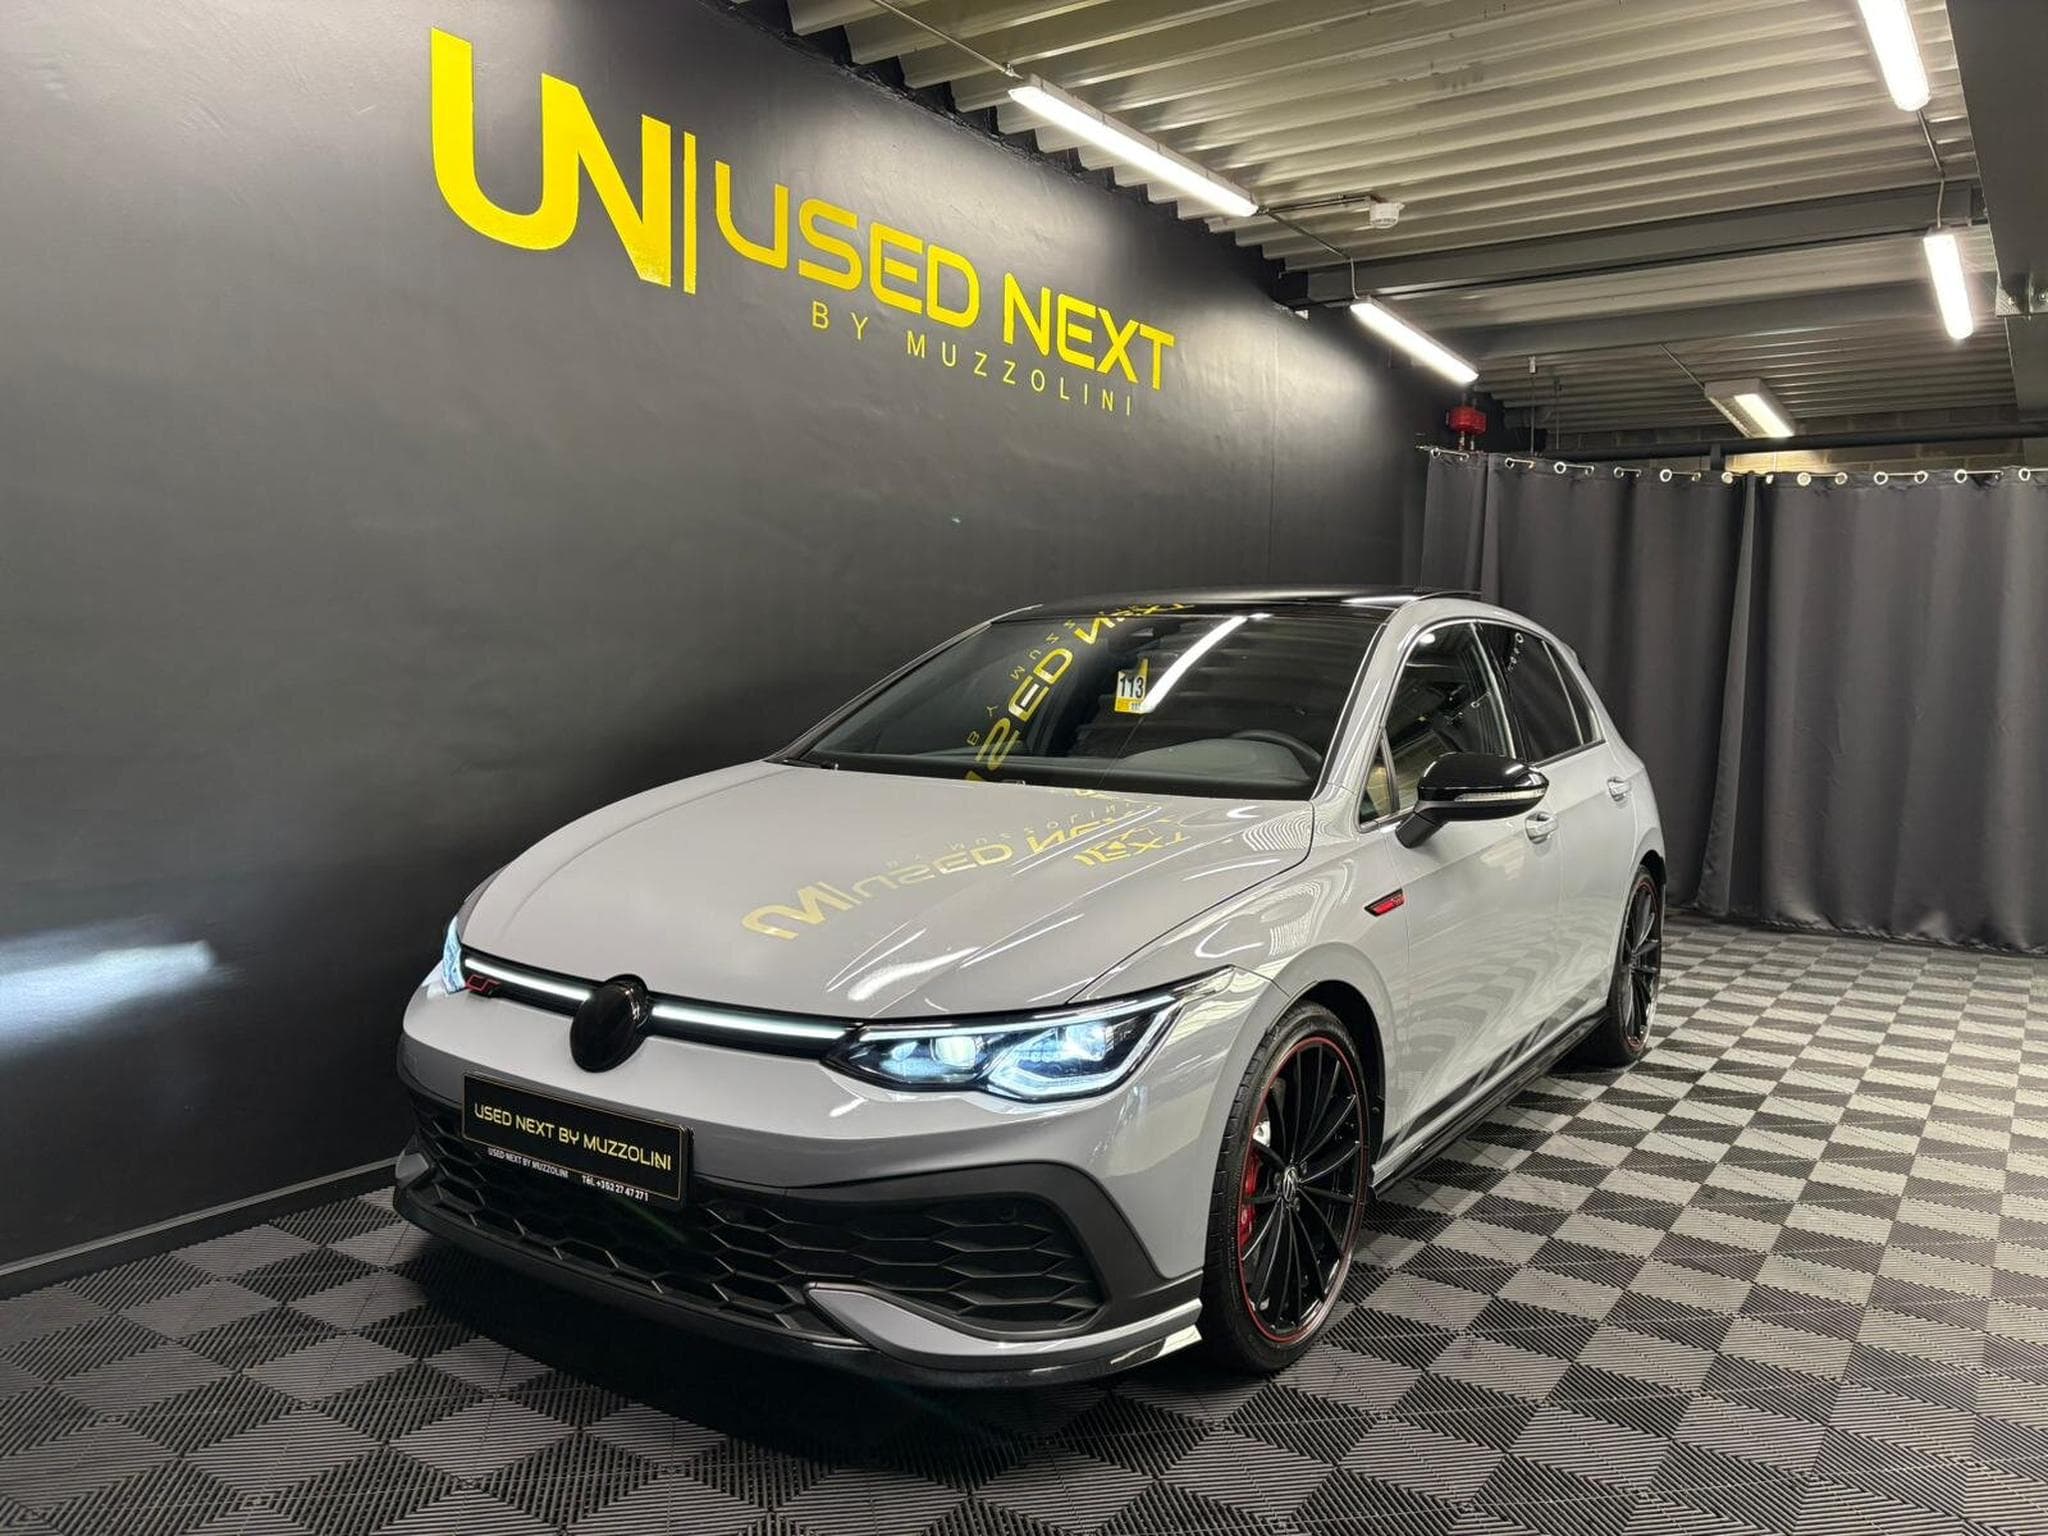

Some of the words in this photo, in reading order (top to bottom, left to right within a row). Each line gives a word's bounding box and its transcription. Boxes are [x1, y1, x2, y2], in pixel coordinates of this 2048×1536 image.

[715, 160, 981, 328] USED
[1002, 272, 1175, 390] NEXT
[811, 301, 869, 340] BY
[906, 330, 1132, 416] MUZZOLINI
[1119, 674, 1145, 699] 113
[474, 1103, 513, 1126] USED
[515, 1114, 555, 1139] NEXT
[558, 1127, 579, 1145] BY
[583, 1133, 672, 1171] MUZZOLINI
[487, 1147, 505, 1160] USED
[505, 1153, 522, 1164] NEXT
[522, 1157, 531, 1168] BY
[532, 1160, 569, 1178] MUZZOLINI
[615, 1184, 625, 1194] 27
[625, 1187, 634, 1198] 47
